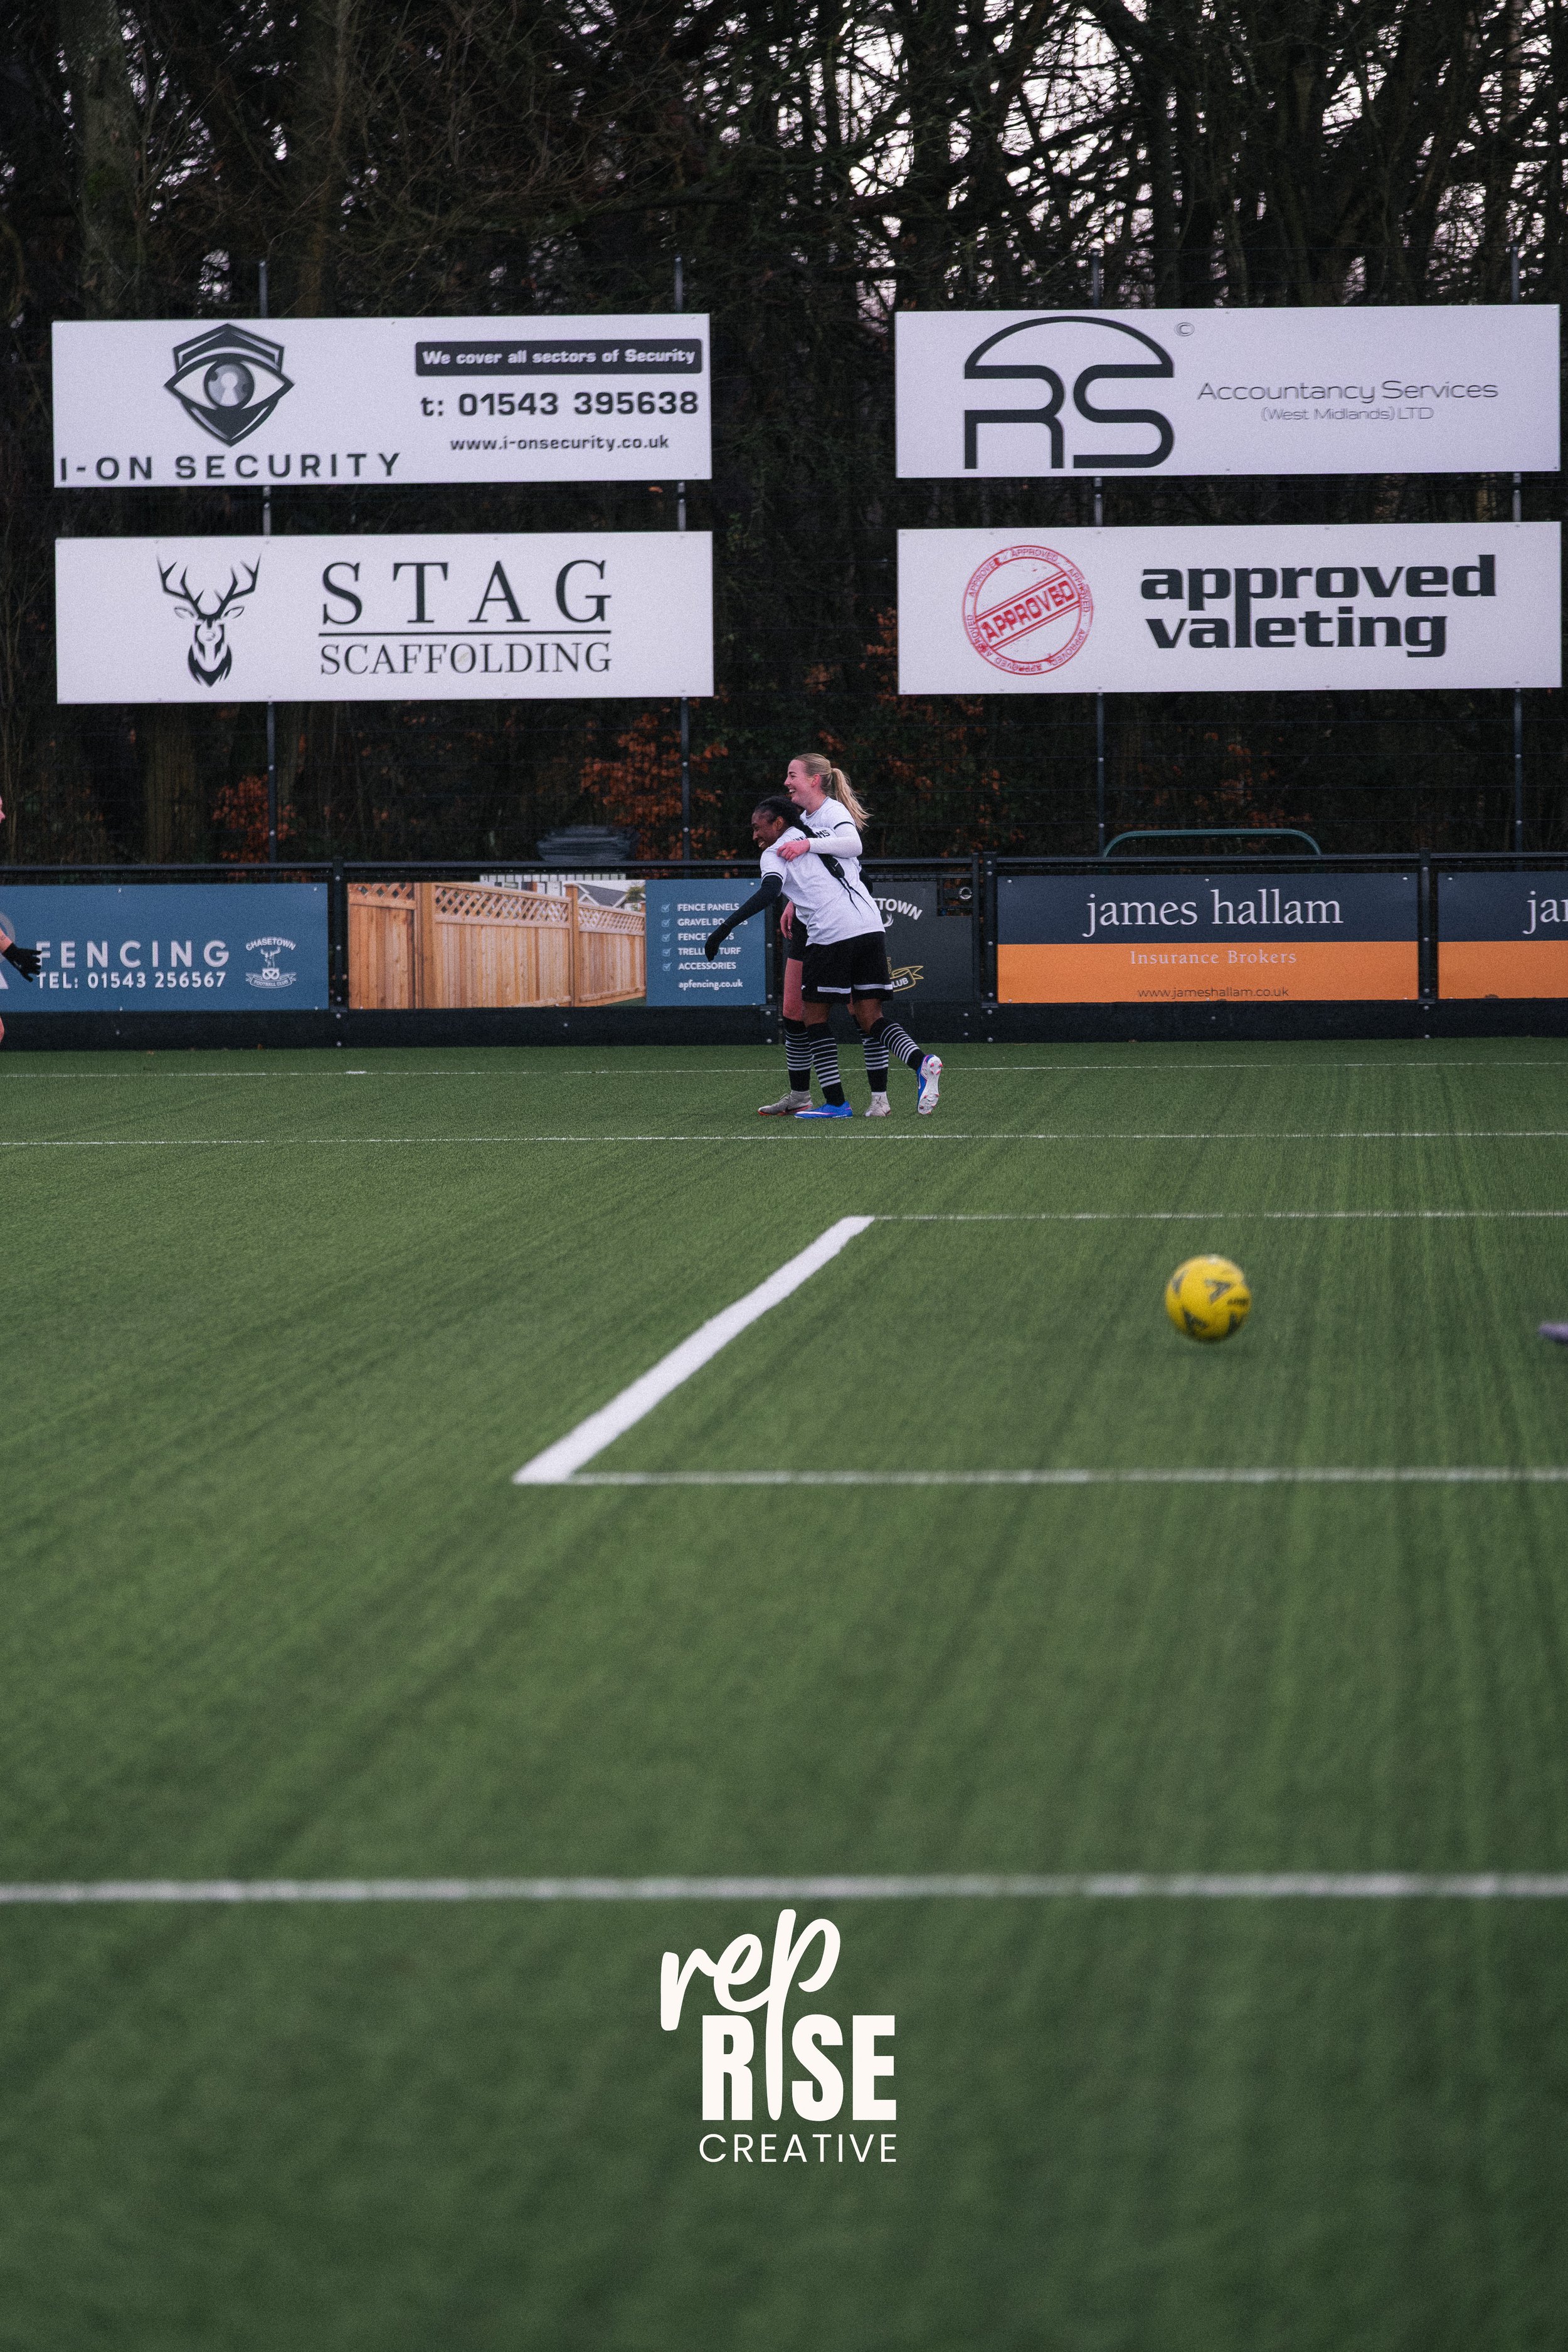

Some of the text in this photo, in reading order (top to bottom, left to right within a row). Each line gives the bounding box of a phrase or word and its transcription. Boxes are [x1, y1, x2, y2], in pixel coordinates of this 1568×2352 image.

[422, 348, 696, 365] We cover all sectors of Security
[1197, 379, 1499, 405] Accountancy Services
[420, 391, 699, 417] t: 01543 395638
[965, 364, 1175, 469] RS
[1261, 406, 1434, 421] (West Midlands) LTD
[450, 434, 669, 452] www.i-onsecurity.co.uk
[60, 452, 400, 482] I-ON SECURITY
[322, 559, 612, 625] STAG
[1140, 554, 1497, 612] approved
[980, 580, 1075, 644] APPROVED
[1145, 605, 1448, 658] valeting
[320, 642, 611, 675] SCAFFOLDING
[677, 903, 739, 912] FENCE PANELS
[1082, 888, 1343, 938] james hallam
[677, 918, 711, 926] GRAVEL
[245, 936, 296, 951] CHASETOWN
[678, 932, 706, 941] FENCE
[36, 940, 230, 968] FENCING
[678, 946, 741, 955] TRELLI TURF
[1130, 948, 1297, 965] Insurance Brokers
[678, 961, 737, 970] ACCESSORIES
[36, 971, 226, 989] TEL: 01543 256567
[678, 979, 743, 991] apfencing.co.uk
[1137, 987, 1290, 1000] www.jameshallam.co.uk
